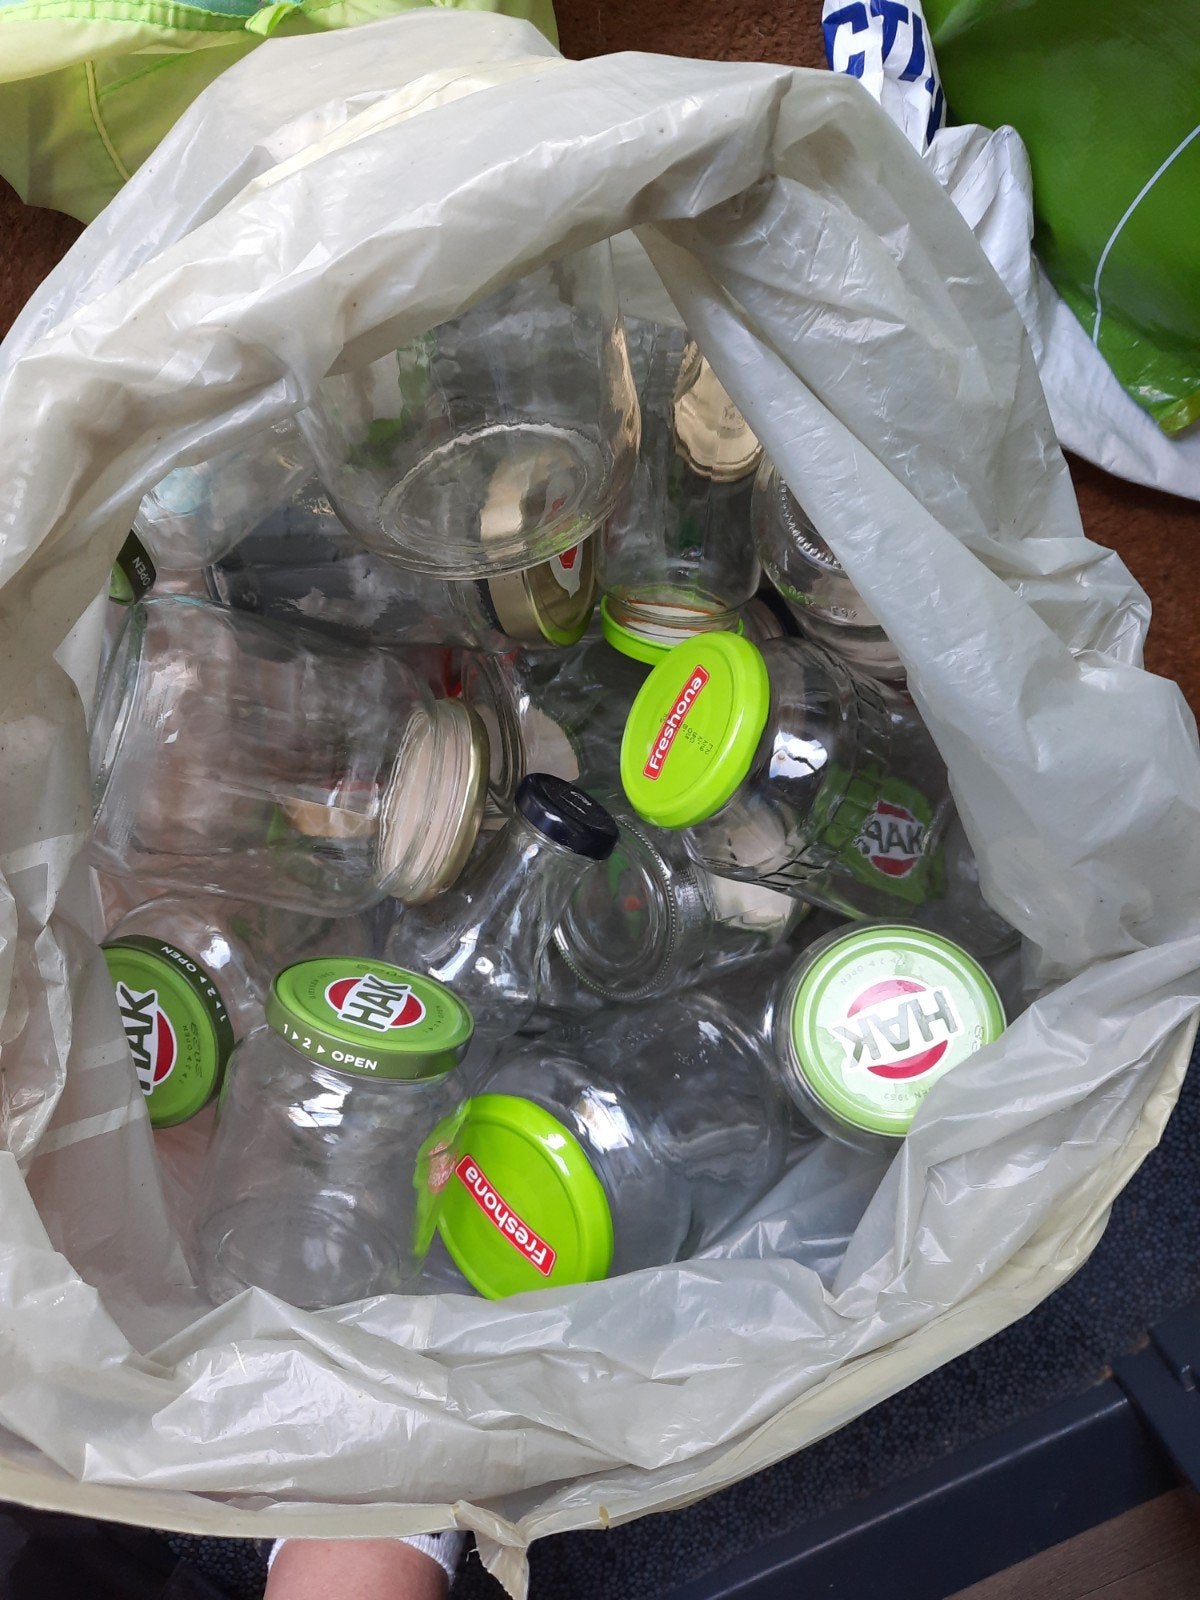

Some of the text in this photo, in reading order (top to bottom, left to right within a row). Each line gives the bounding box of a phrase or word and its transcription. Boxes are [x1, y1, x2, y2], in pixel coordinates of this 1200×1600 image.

[132, 556, 151, 586] OPEN
[649, 677, 702, 770] Freshona
[161, 946, 197, 973] OPEN
[207, 987, 217, 997] 2
[342, 975, 408, 1030] HAK
[283, 1024, 378, 1071] 1 2 OPEN
[832, 990, 958, 1068] HAK
[465, 1166, 547, 1266] Freshona
